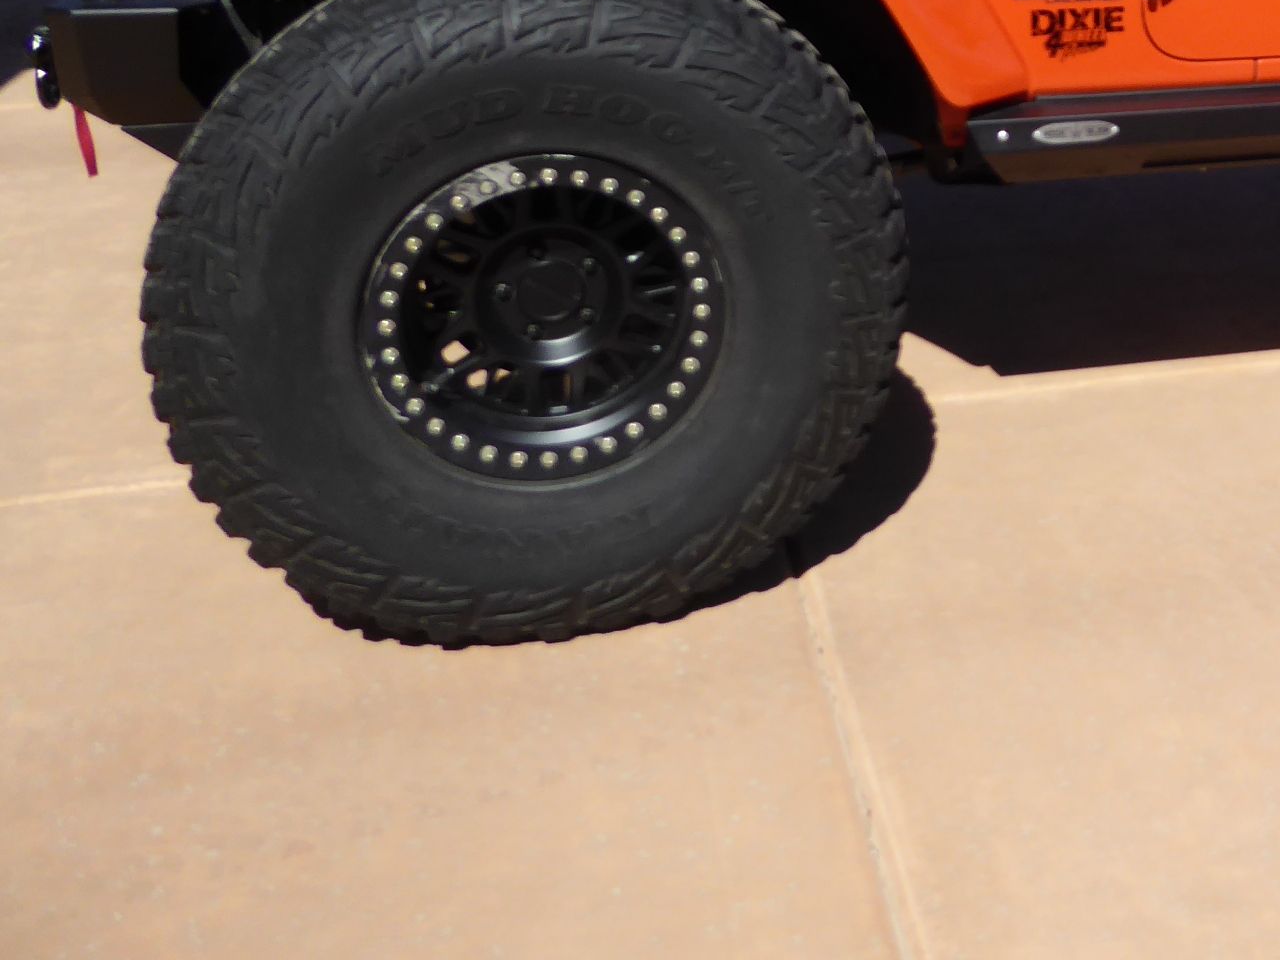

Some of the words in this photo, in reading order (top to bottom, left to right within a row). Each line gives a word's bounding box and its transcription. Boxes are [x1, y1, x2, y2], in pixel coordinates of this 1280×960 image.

[1031, 6, 1125, 36] DIXIE
[372, 86, 529, 178] MUD
[541, 83, 699, 146] HOG
